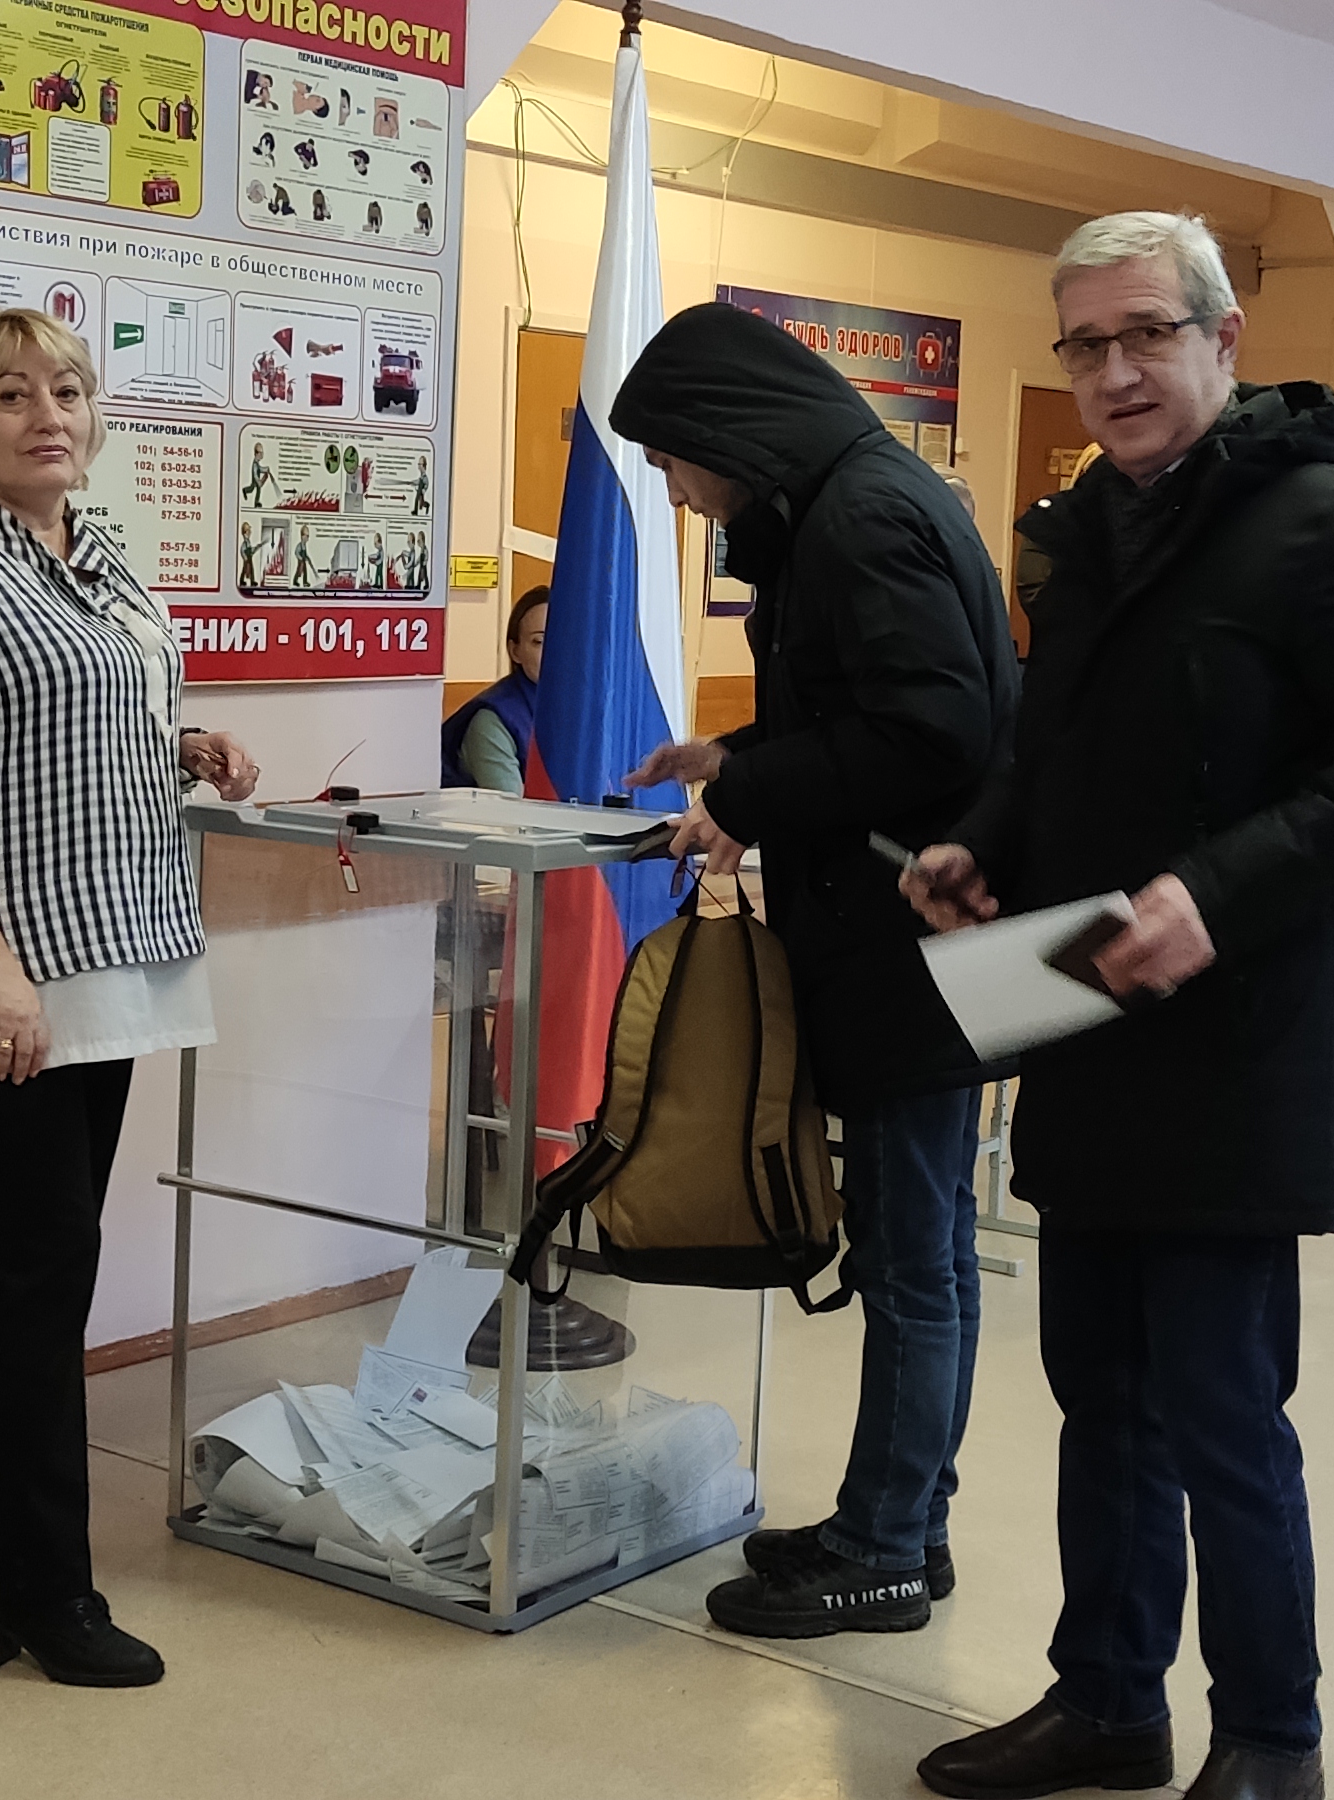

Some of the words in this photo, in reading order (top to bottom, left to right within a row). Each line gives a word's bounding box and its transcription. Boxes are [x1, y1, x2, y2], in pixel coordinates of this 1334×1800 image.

[174, 0, 450, 65] зопасности
[79, 236, 117, 256] при
[125, 243, 203, 269] пожаре
[211, 255, 220, 269] в
[227, 254, 367, 290] общественном
[372, 277, 424, 296] месте
[836, 327, 902, 361] ЗДОРОВ
[129, 422, 202, 437] РЕАГИРОВАНИЯ
[86, 506, 109, 517] ФСБ
[109, 523, 124, 534] ЧС
[171, 618, 267, 652] ЕНИЯ
[300, 618, 366, 658] 101,
[375, 618, 429, 651] 112
